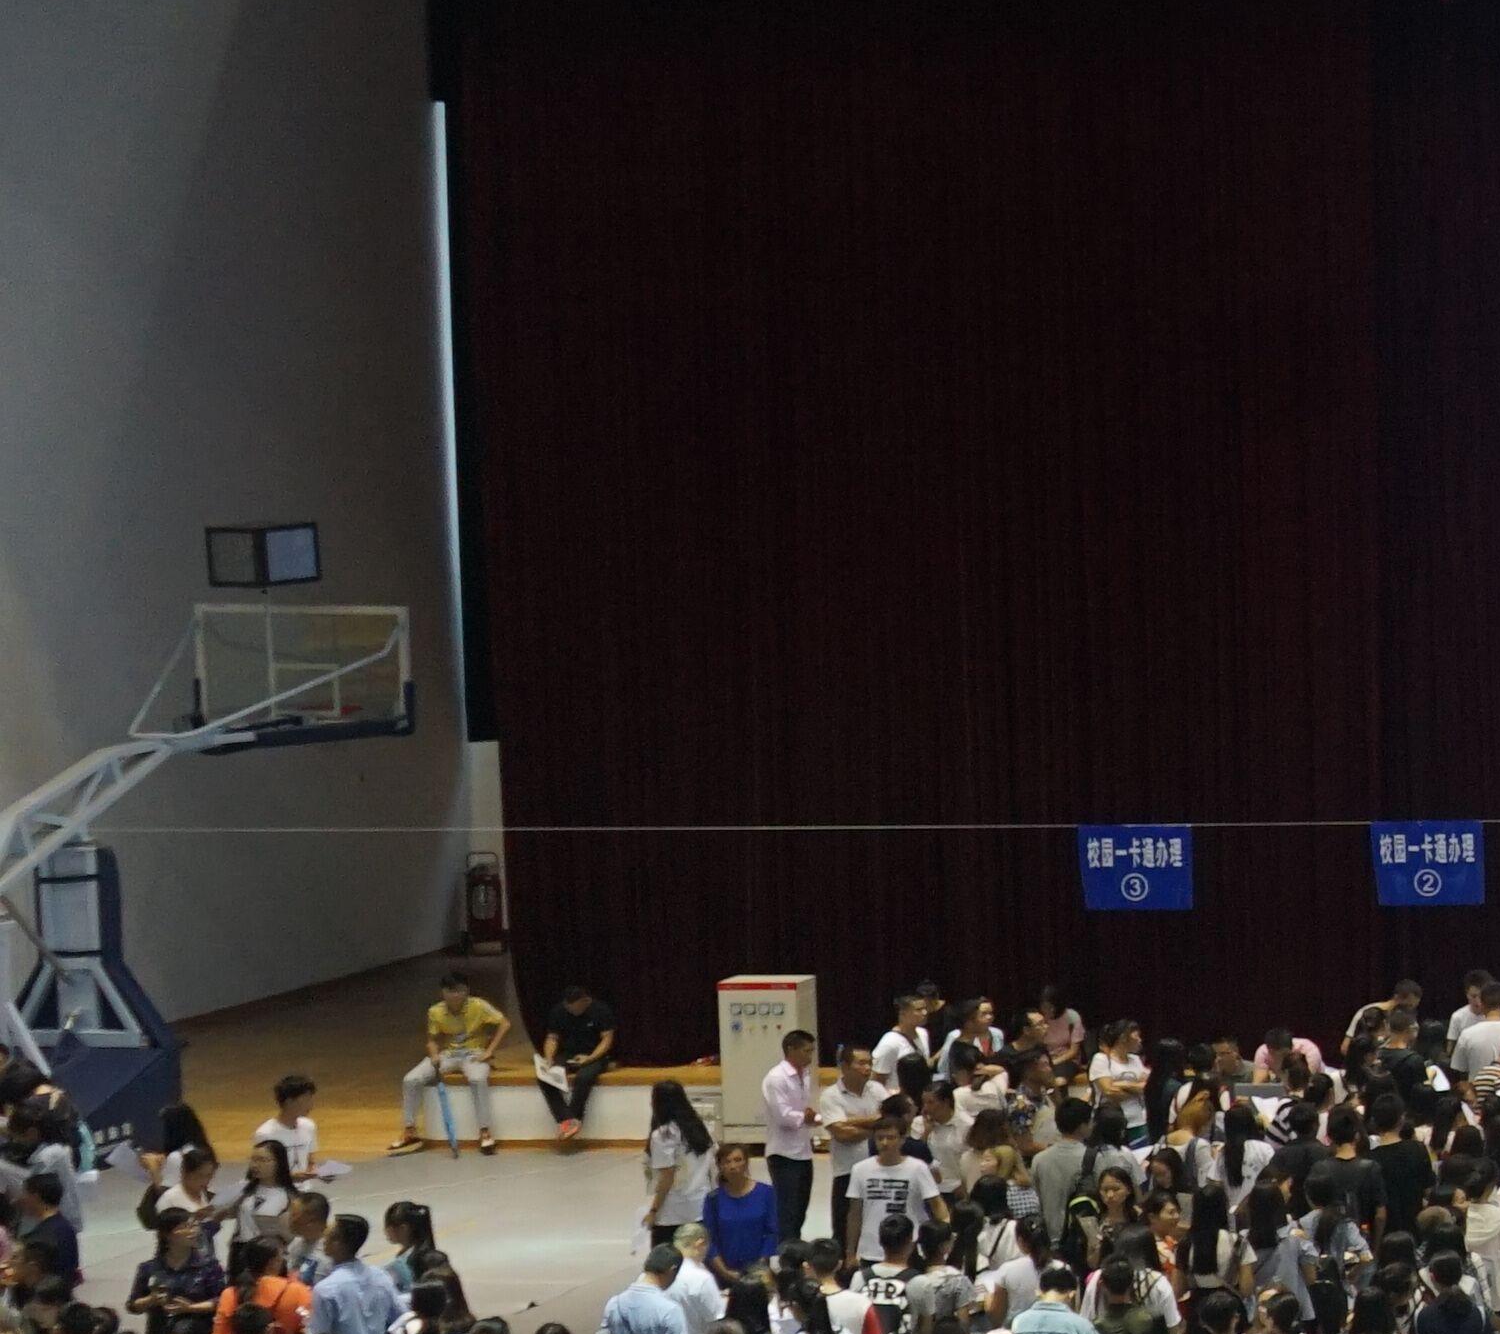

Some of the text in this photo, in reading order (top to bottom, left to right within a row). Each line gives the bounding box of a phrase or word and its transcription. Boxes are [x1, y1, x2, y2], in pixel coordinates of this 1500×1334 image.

[1087, 837, 1183, 868] 校园一卡通办理
[1380, 833, 1476, 864] 校园一卡通办理
